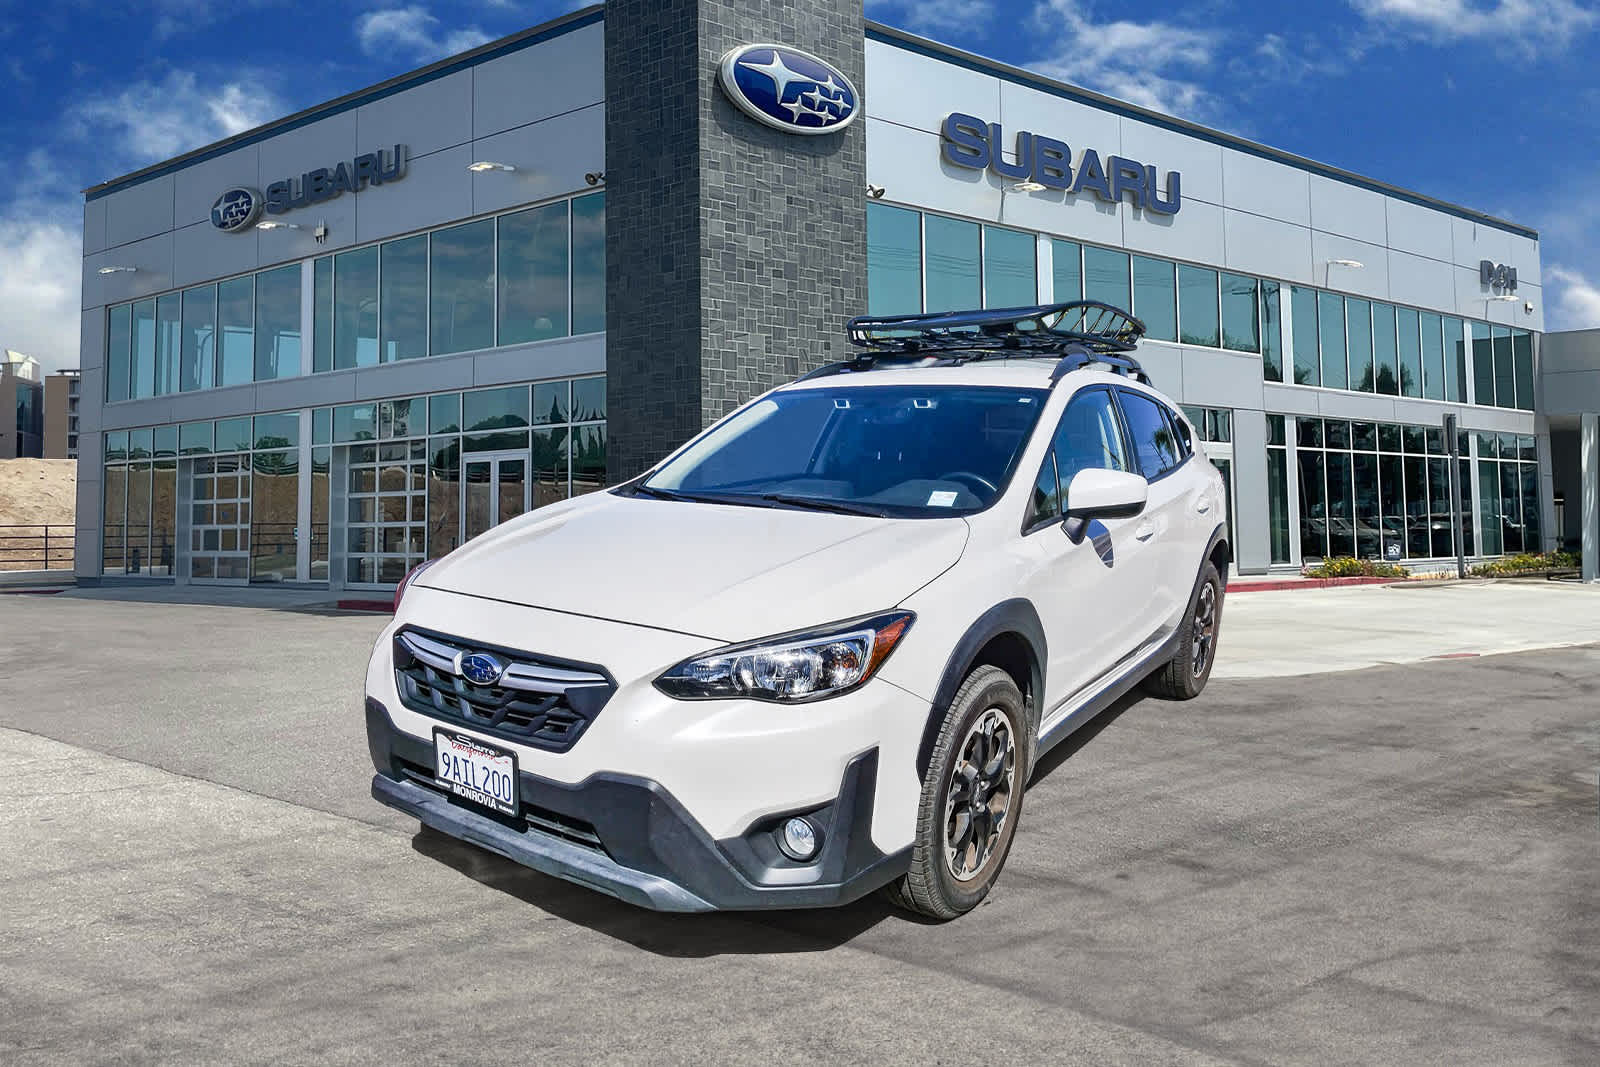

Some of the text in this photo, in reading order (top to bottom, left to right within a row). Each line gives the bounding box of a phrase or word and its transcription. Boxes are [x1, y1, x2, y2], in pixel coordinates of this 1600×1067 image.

[266, 144, 405, 214] SUBARU
[942, 112, 1181, 215] SUBARU
[442, 752, 511, 802] 9AIL200
[453, 783, 497, 809] MONROVIA
